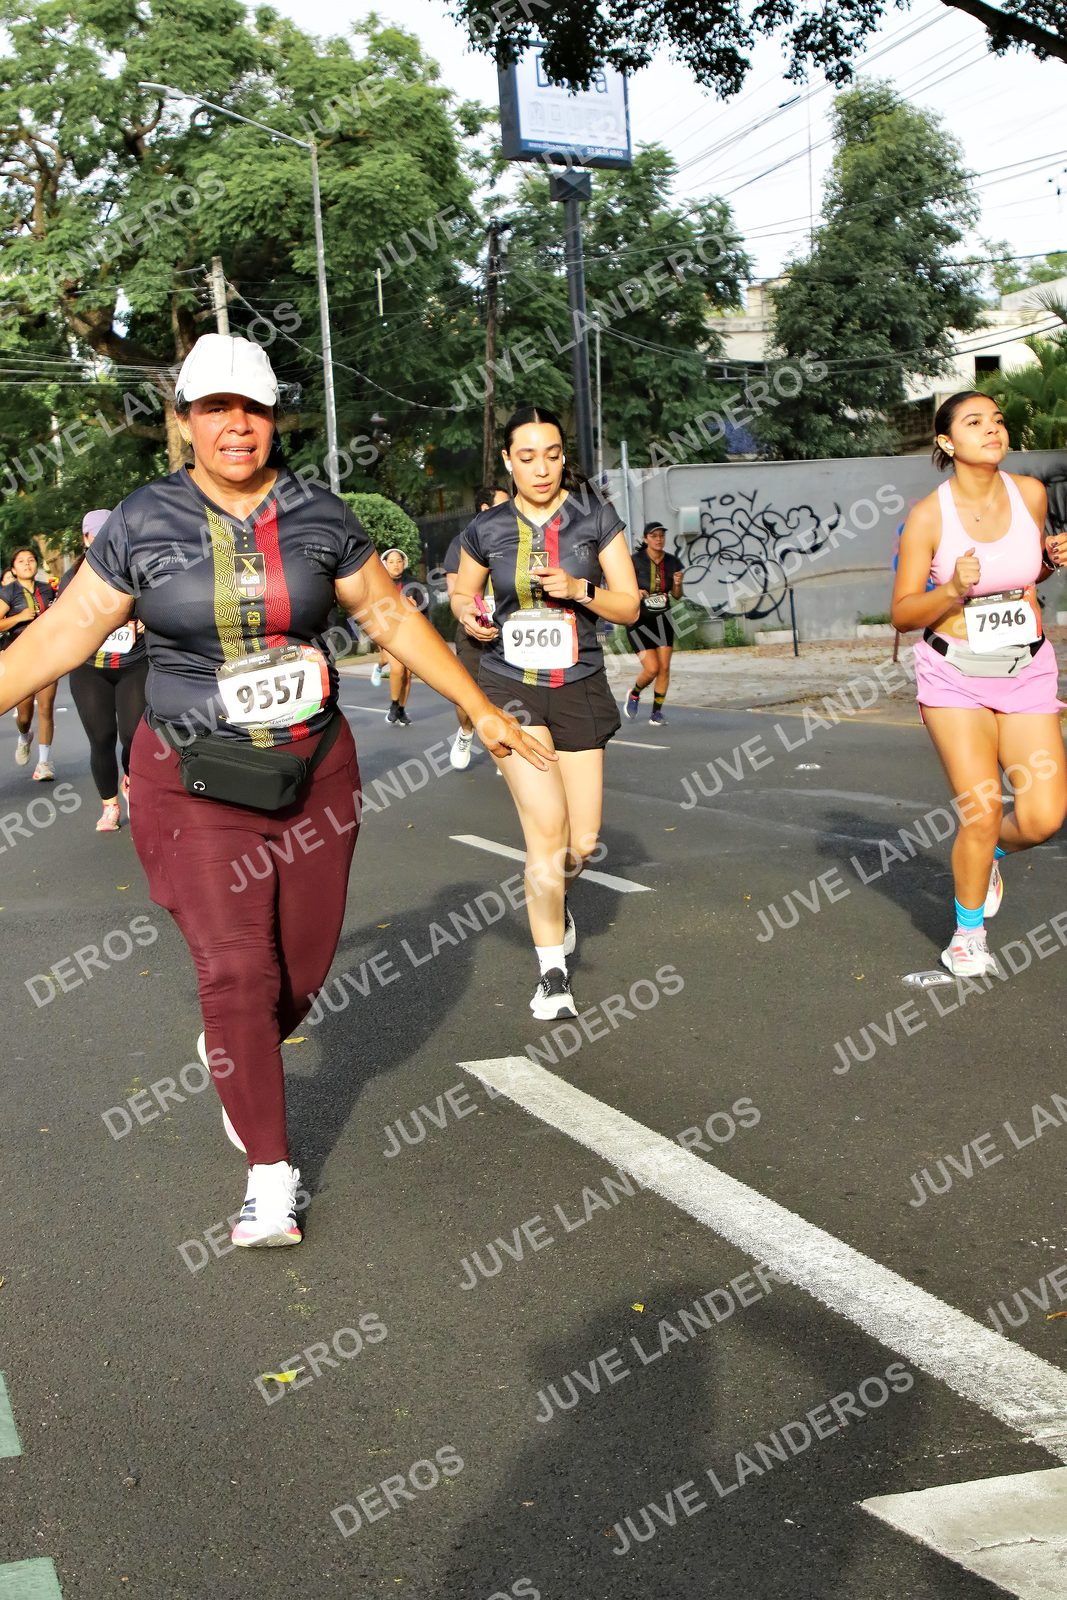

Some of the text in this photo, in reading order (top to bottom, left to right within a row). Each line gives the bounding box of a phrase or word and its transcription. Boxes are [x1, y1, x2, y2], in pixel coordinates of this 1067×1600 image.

[701, 489, 758, 511] TOY
[976, 608, 1026, 632] 7946
[106, 631, 130, 641] 967
[512, 628, 561, 647] 9560
[237, 670, 305, 713] 9557
